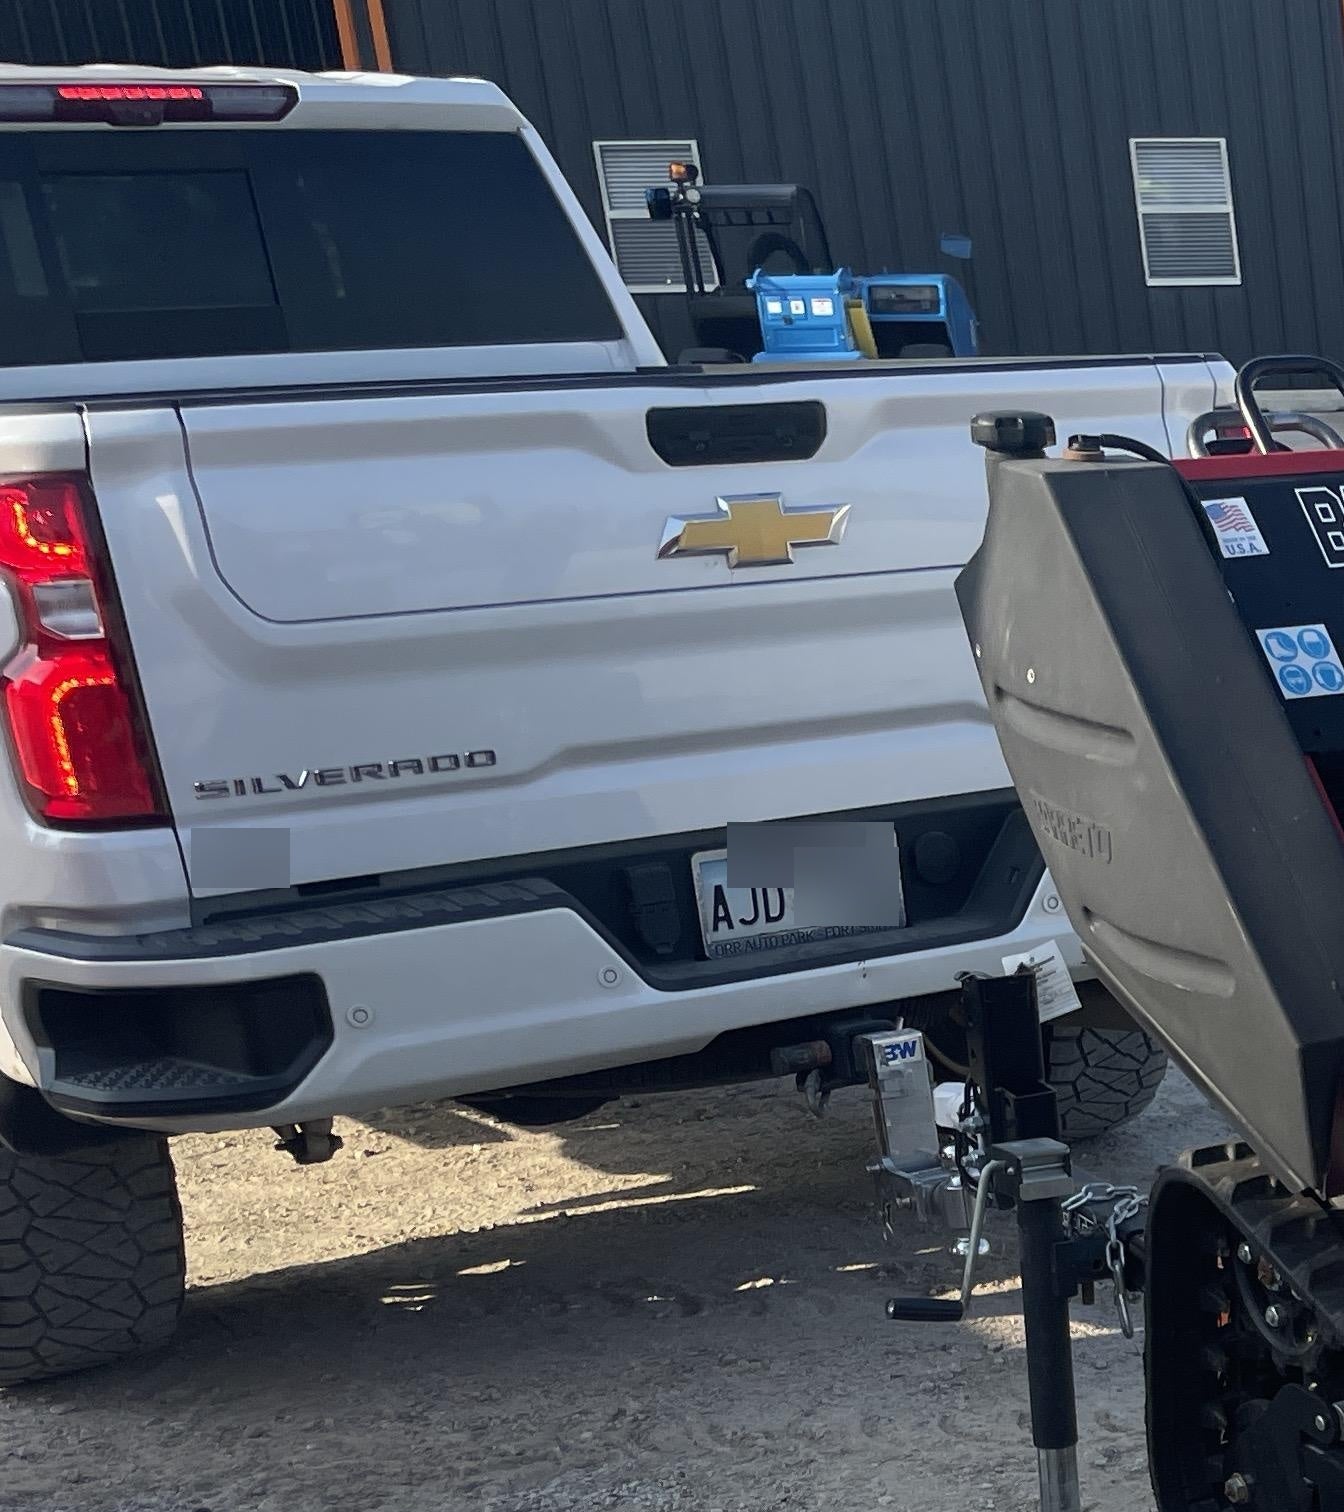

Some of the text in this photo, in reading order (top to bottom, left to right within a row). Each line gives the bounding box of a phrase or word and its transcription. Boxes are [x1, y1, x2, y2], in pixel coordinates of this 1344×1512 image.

[194, 749, 496, 801] SILVERADO
[744, 935, 779, 951] AUTO
[782, 930, 816, 946] PARK
